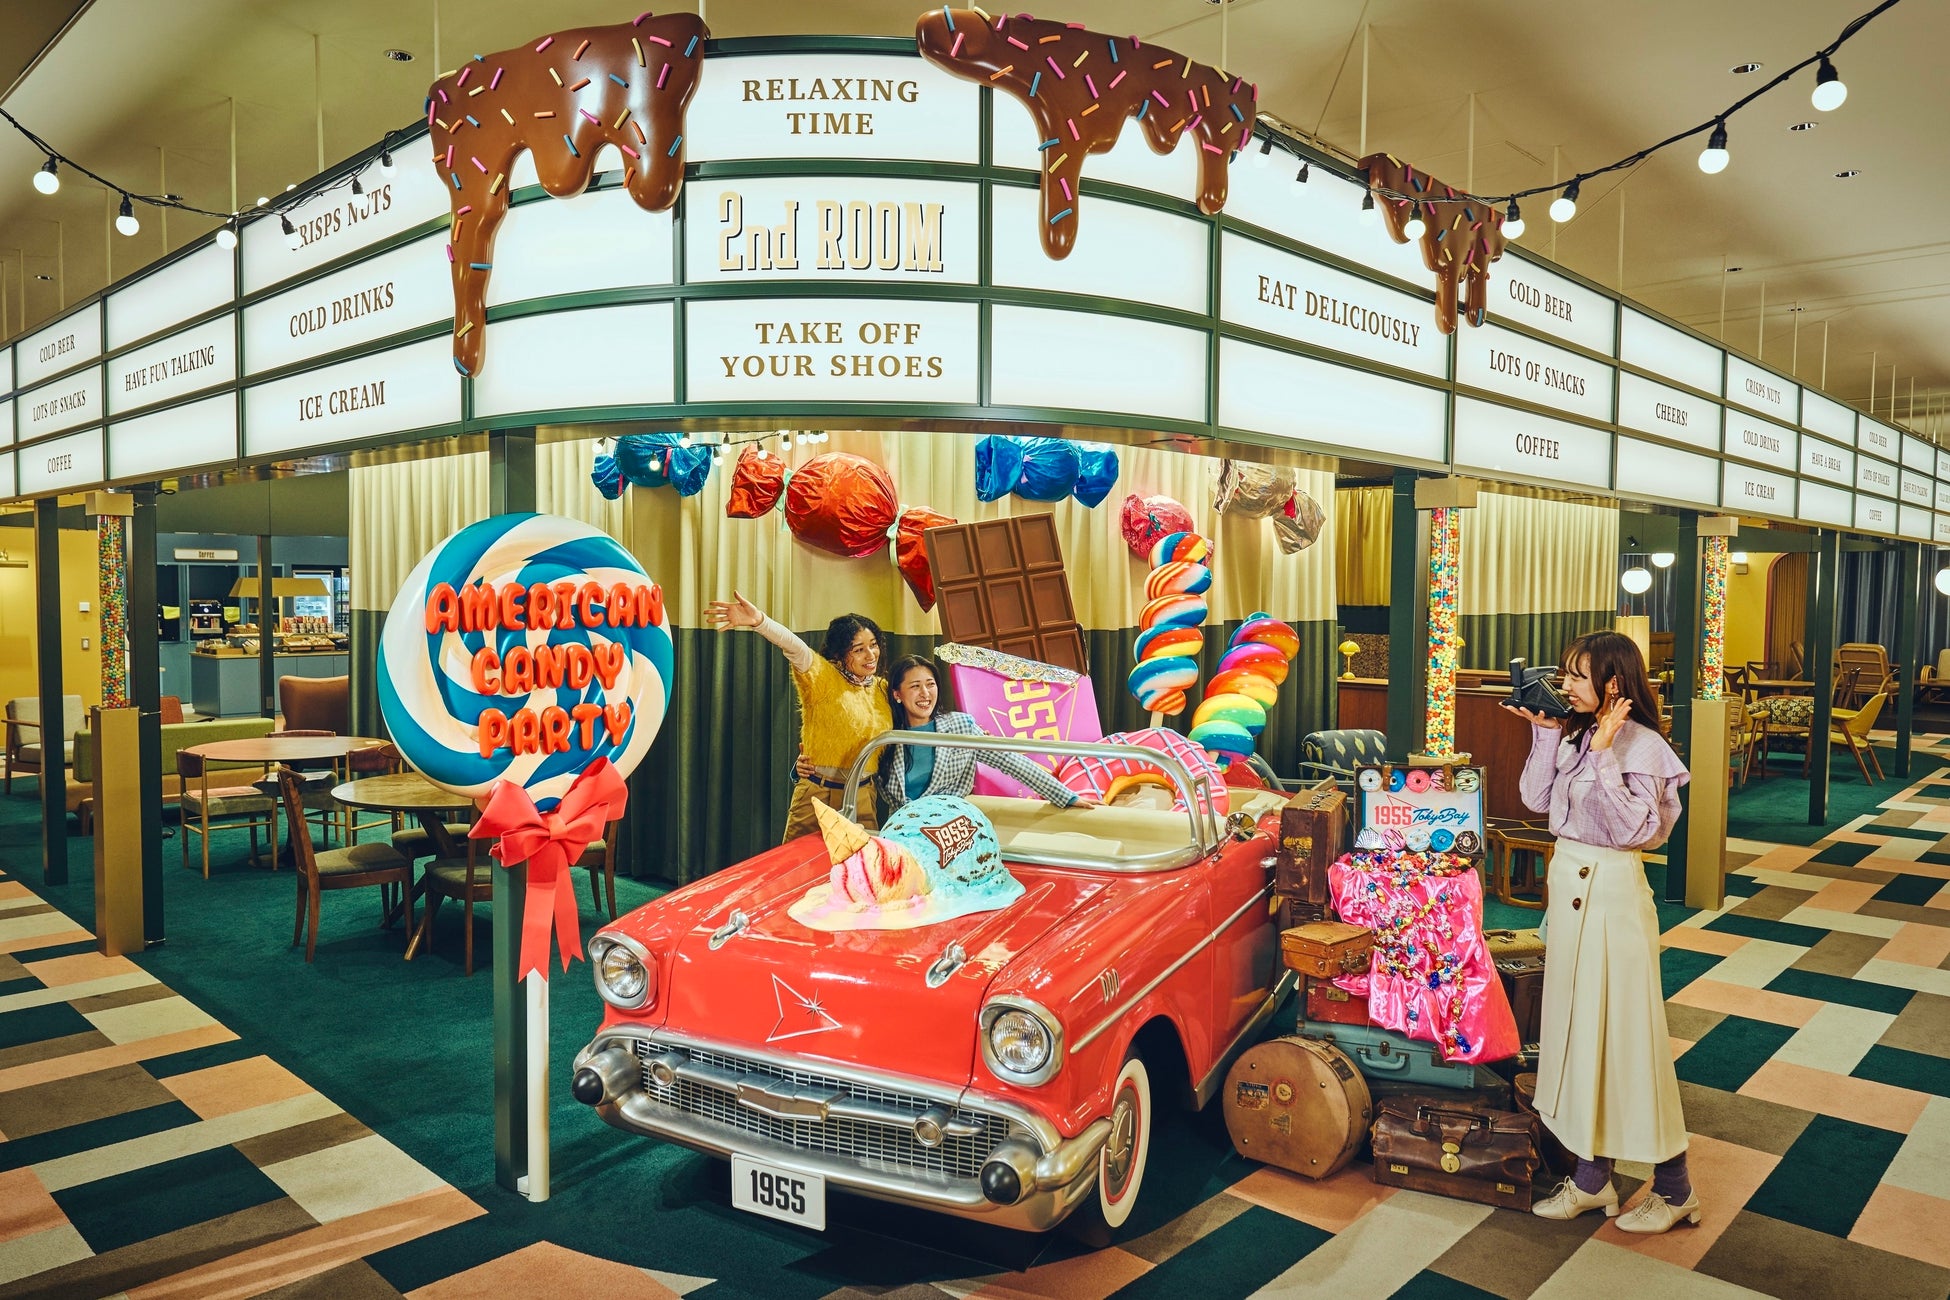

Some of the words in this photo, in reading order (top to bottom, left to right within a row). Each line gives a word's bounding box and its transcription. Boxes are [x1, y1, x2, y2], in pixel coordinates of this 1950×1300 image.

[742, 78, 919, 102] RELAXING
[787, 112, 873, 135] TIME
[292, 207, 340, 251] RISPS
[348, 184, 392, 226] NUTS
[719, 191, 799, 272] 2nd
[816, 200, 944, 272] ROOM
[290, 306, 327, 338] COLD
[332, 282, 394, 325] DRINKS
[1257, 275, 1297, 310] EAT
[1305, 290, 1420, 347] DELICIOUSLY
[1510, 279, 1540, 308] COLD
[1545, 293, 1573, 322] BEER
[39, 343, 55, 363] COLD
[58, 334, 75, 355] BEER
[755, 322, 843, 345] TAKE
[858, 322, 921, 344] OFF
[125, 368, 147, 392] HAVE
[150, 361, 168, 383] FUN
[171, 345, 214, 376] TALKING
[720, 355, 816, 378] YOUR
[830, 355, 943, 378] SHOES
[1490, 349, 1521, 377] LOTS
[1526, 361, 1540, 382] OF
[1545, 367, 1585, 396] SNACKS
[33, 403, 48, 422] LOTS
[49, 399, 58, 416] OF
[60, 389, 86, 413] SNACKS
[299, 395, 323, 421] ICE
[329, 381, 385, 415] CREAM
[1745, 378, 1765, 398] CRISPS
[1766, 387, 1781, 404] NUTS
[1655, 402, 1688, 426] CHEERS!
[1516, 433, 1559, 459] COFFEE
[1743, 430, 1759, 446] COLD
[1759, 434, 1780, 453] DRINKS
[1869, 431, 1878, 444] COLD
[1878, 435, 1887, 448] BEER
[47, 454, 72, 473] COFFEE
[1811, 452, 1823, 467] HAVE
[1824, 457, 1828, 468] A
[1828, 457, 1841, 472] BREAK
[1744, 481, 1754, 496] ICE
[1756, 483, 1775, 500] CREAM
[425, 581, 663, 634] AMERICAN
[471, 642, 624, 695] CANDY
[478, 702, 631, 759] PARTY
[1374, 805, 1412, 825] 1955
[935, 818, 969, 849] 1955
[750, 1169, 805, 1215] 1955
